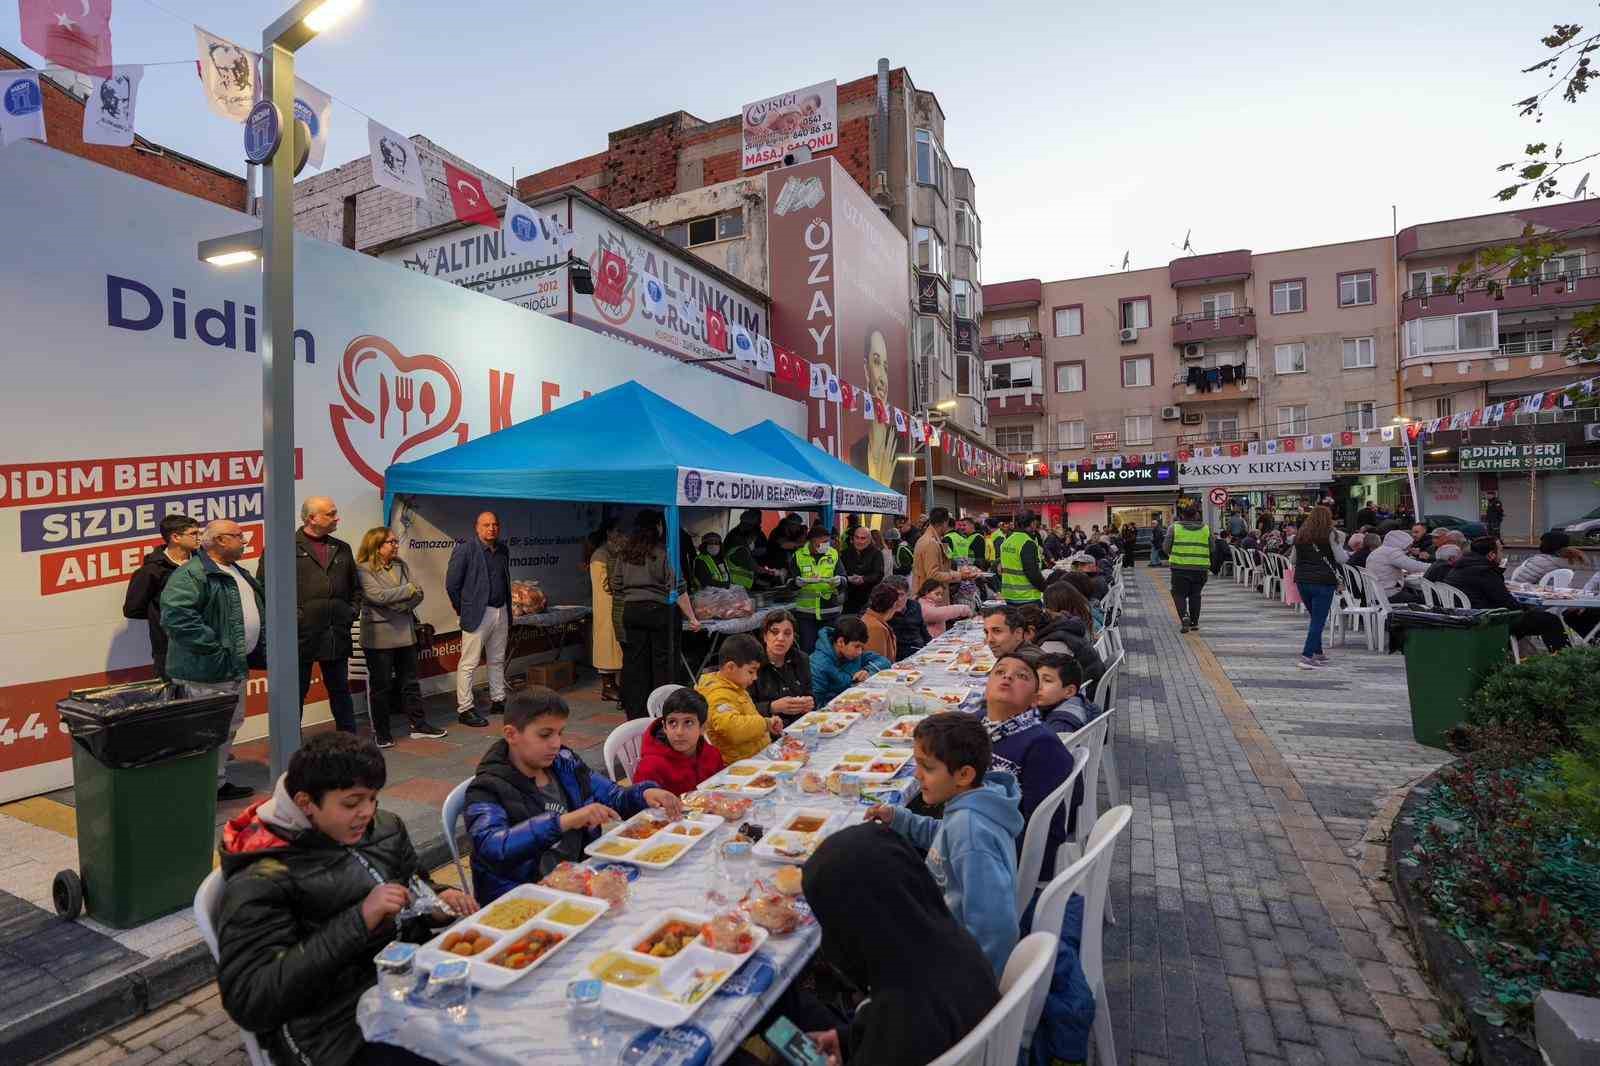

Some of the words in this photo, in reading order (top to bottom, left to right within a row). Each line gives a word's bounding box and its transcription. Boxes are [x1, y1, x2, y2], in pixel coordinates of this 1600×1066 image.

[745, 147, 784, 166] MASAJ
[537, 280, 559, 294] 2012
[1193, 463, 1241, 476] AKSOY
[1248, 458, 1331, 475] KIRTASİYE
[1461, 458, 1520, 470] LEATHER
[1524, 457, 1562, 468] SHOP
[731, 478, 764, 501] DİDİM
